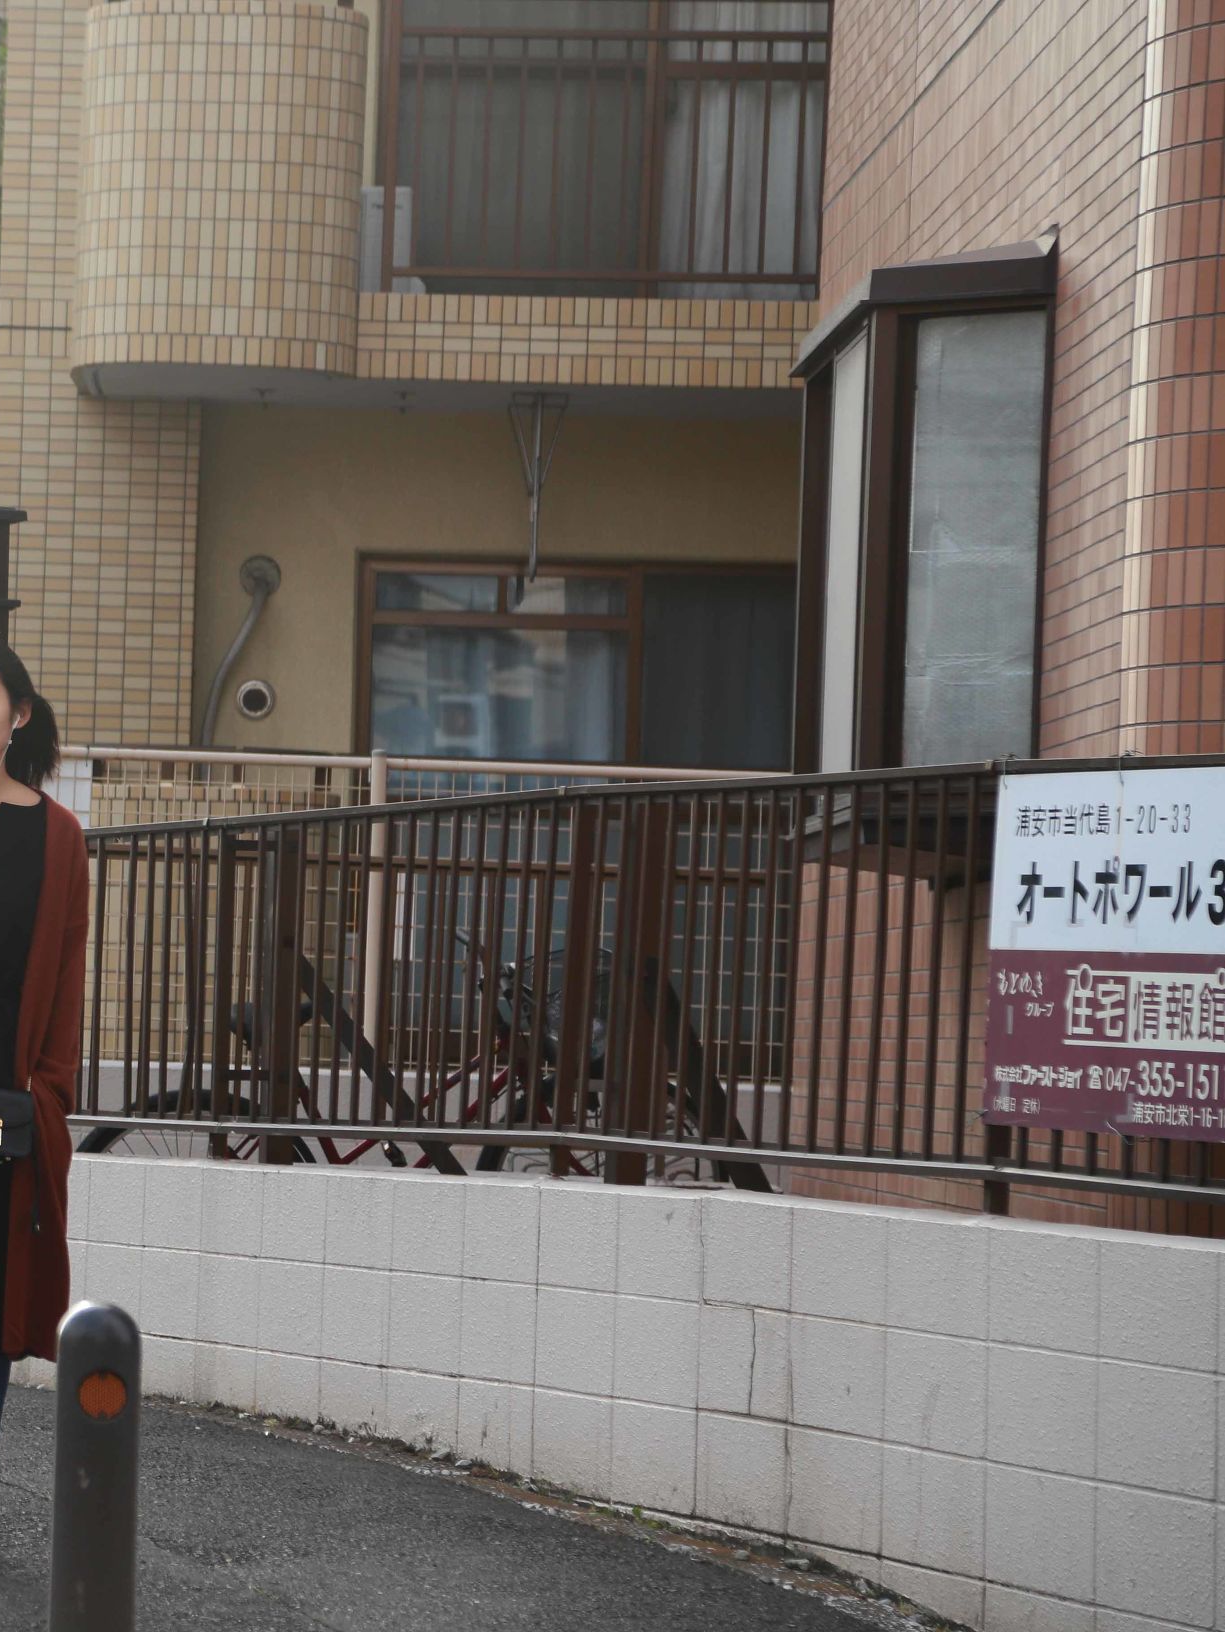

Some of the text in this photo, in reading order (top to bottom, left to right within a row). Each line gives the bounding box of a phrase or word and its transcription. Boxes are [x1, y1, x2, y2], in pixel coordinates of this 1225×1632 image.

[1105, 1060, 1225, 1101] 047-355-151
[1132, 1101, 1225, 1129] 浦安市北栄1-16-1
